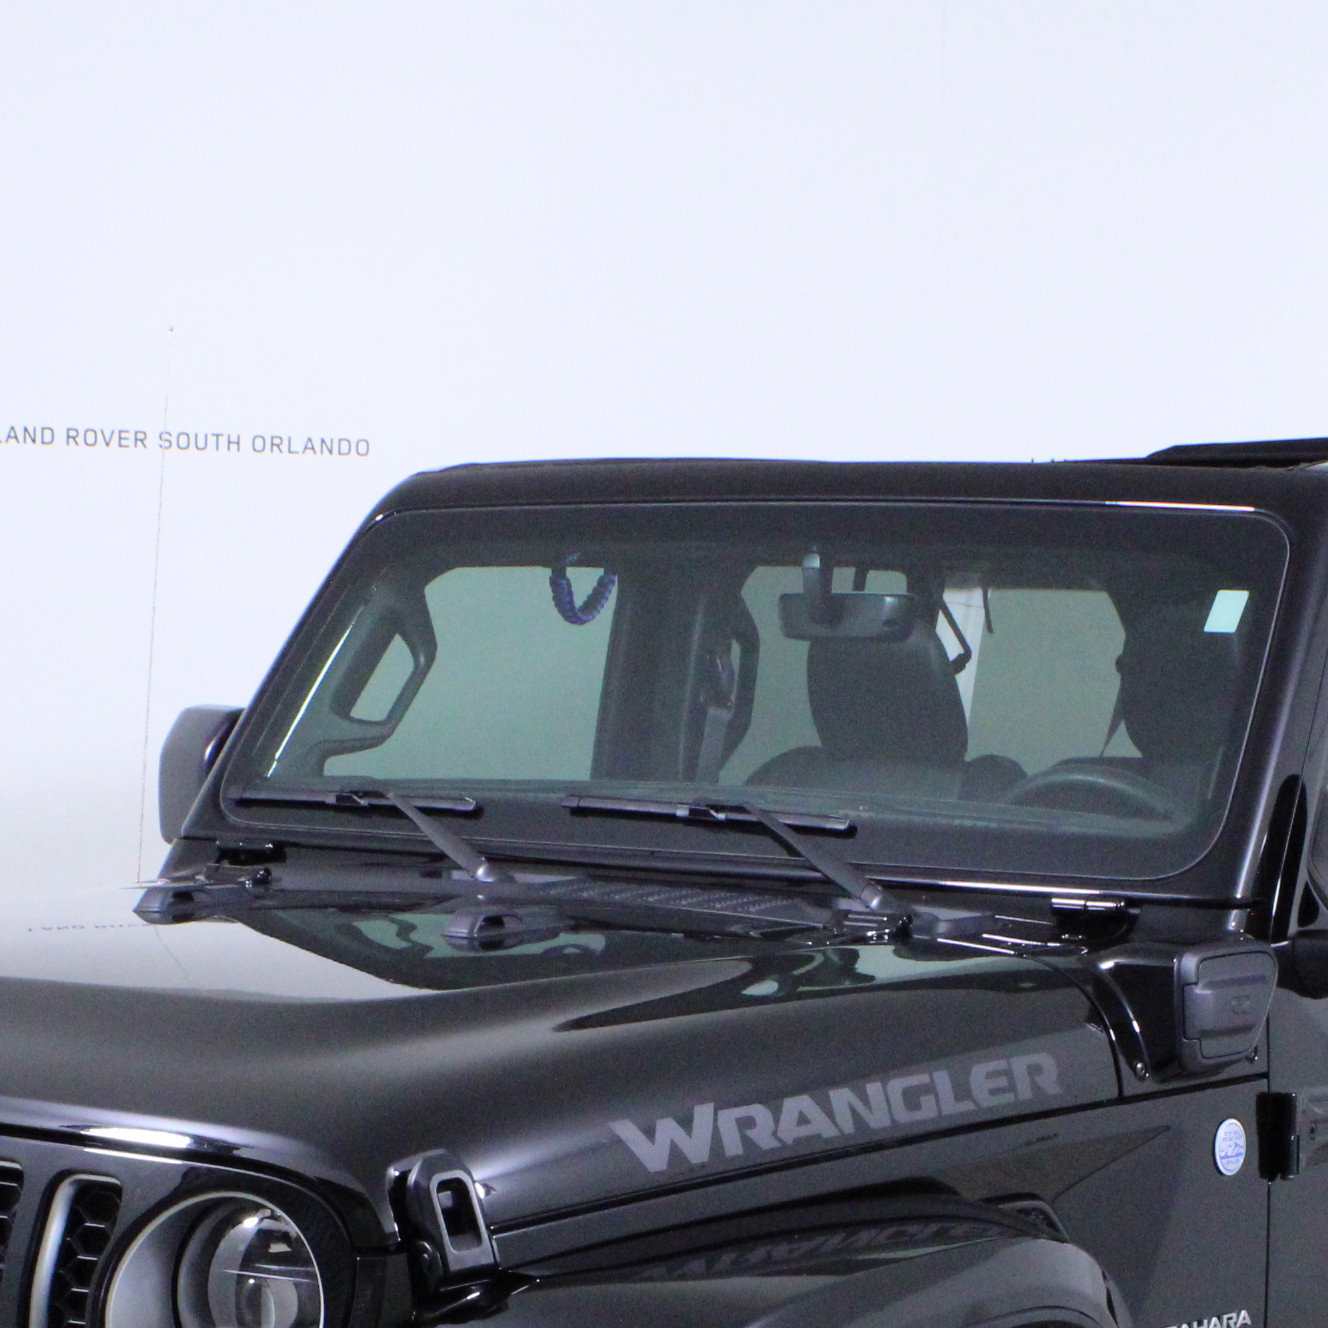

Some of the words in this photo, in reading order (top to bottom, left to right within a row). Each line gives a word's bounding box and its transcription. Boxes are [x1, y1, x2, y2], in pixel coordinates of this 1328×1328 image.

[66, 428, 148, 449] ROVER
[158, 431, 241, 452] SOUTH
[251, 435, 370, 457] ORLANDO
[608, 1051, 1063, 1172] WRANGLER
